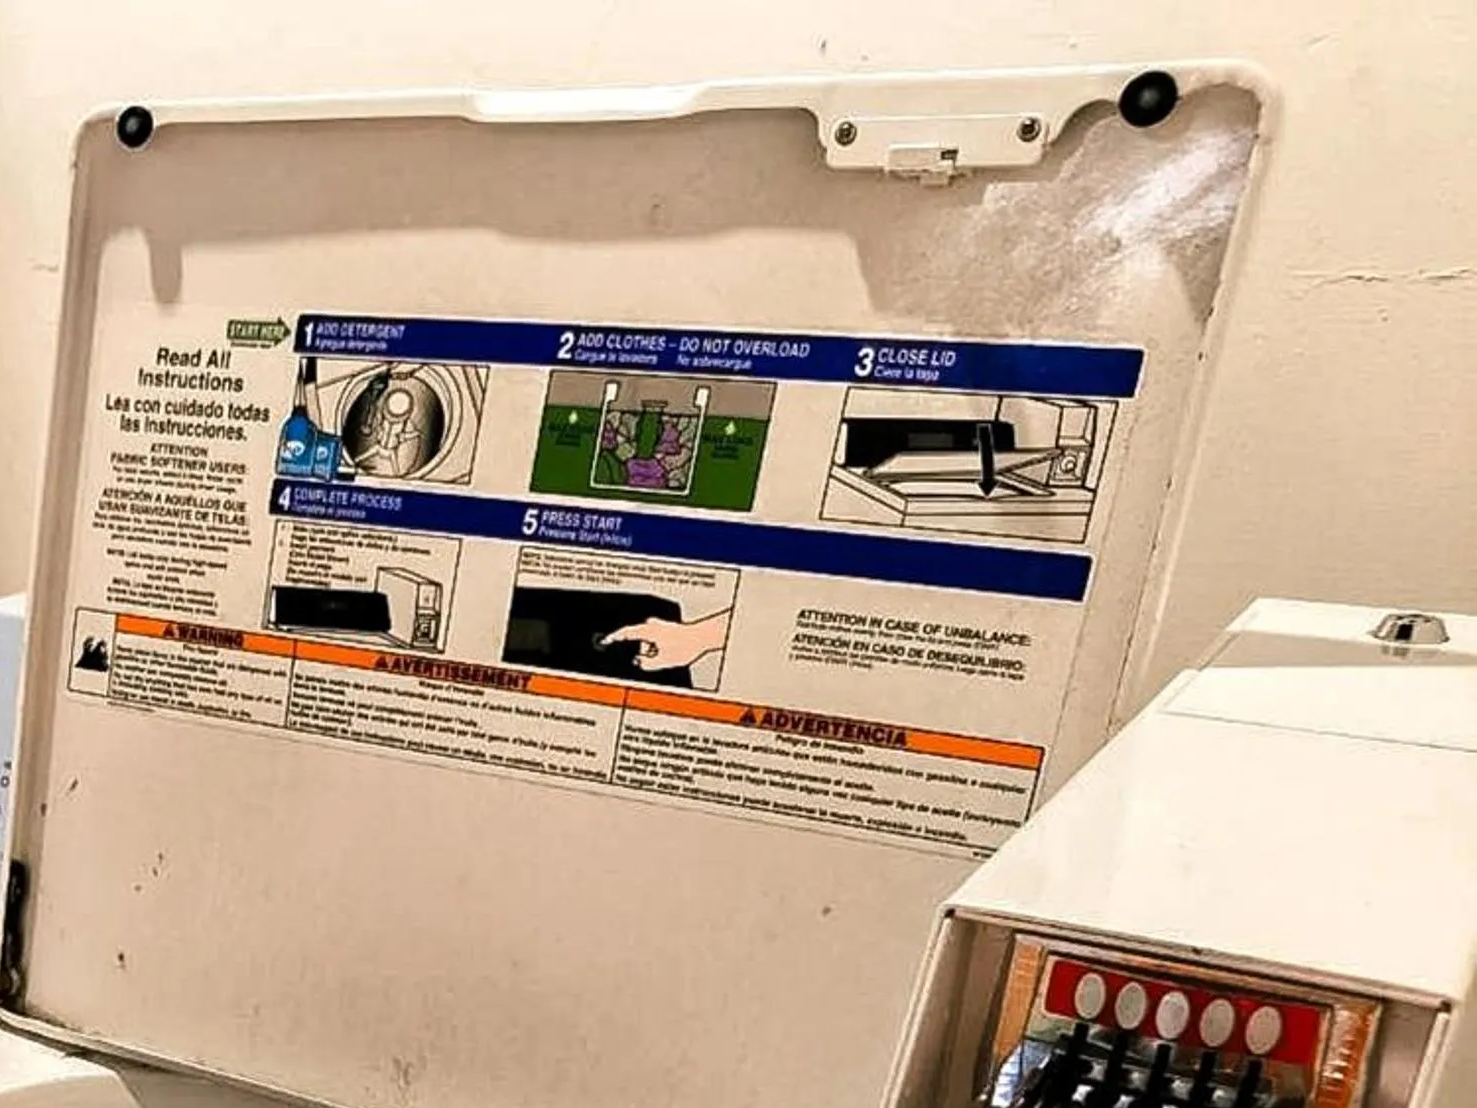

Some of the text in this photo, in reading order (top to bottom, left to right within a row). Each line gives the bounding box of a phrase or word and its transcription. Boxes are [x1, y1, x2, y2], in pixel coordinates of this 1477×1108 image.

[304, 322, 314, 347] 1
[316, 323, 405, 339] ADD DETERGENT
[557, 332, 574, 360] 2
[577, 333, 603, 348] ADD
[606, 335, 666, 351] CLOTHES
[679, 338, 700, 352] DO
[702, 338, 731, 354] NOT
[733, 340, 810, 358] OVERLOAD
[878, 347, 956, 367] CLOSE LID
[156, 348, 231, 369] Read All
[854, 347, 875, 377] 3
[137, 368, 244, 393] Instructions
[105, 393, 270, 422] Lea con cuidado todas
[120, 414, 140, 432] las
[151, 443, 208, 457] ATTENTION
[151, 456, 207, 471] SOFTENER
[278, 485, 291, 511] 4
[293, 487, 403, 511] COMPLETE PROCESS
[522, 508, 539, 535] 5
[541, 509, 622, 531] PRESS START
[797, 609, 867, 627] ATTENTION
[869, 616, 883, 629] IN
[885, 618, 920, 633] CASE
[923, 623, 943, 636] OF
[177, 623, 244, 649] WARNING
[853, 640, 870, 651] EN
[872, 642, 905, 657] CASO
[907, 647, 925, 659] DE
[392, 656, 531, 690] AVERTISSEMENT
[760, 710, 908, 746] ADVERTENCIA
